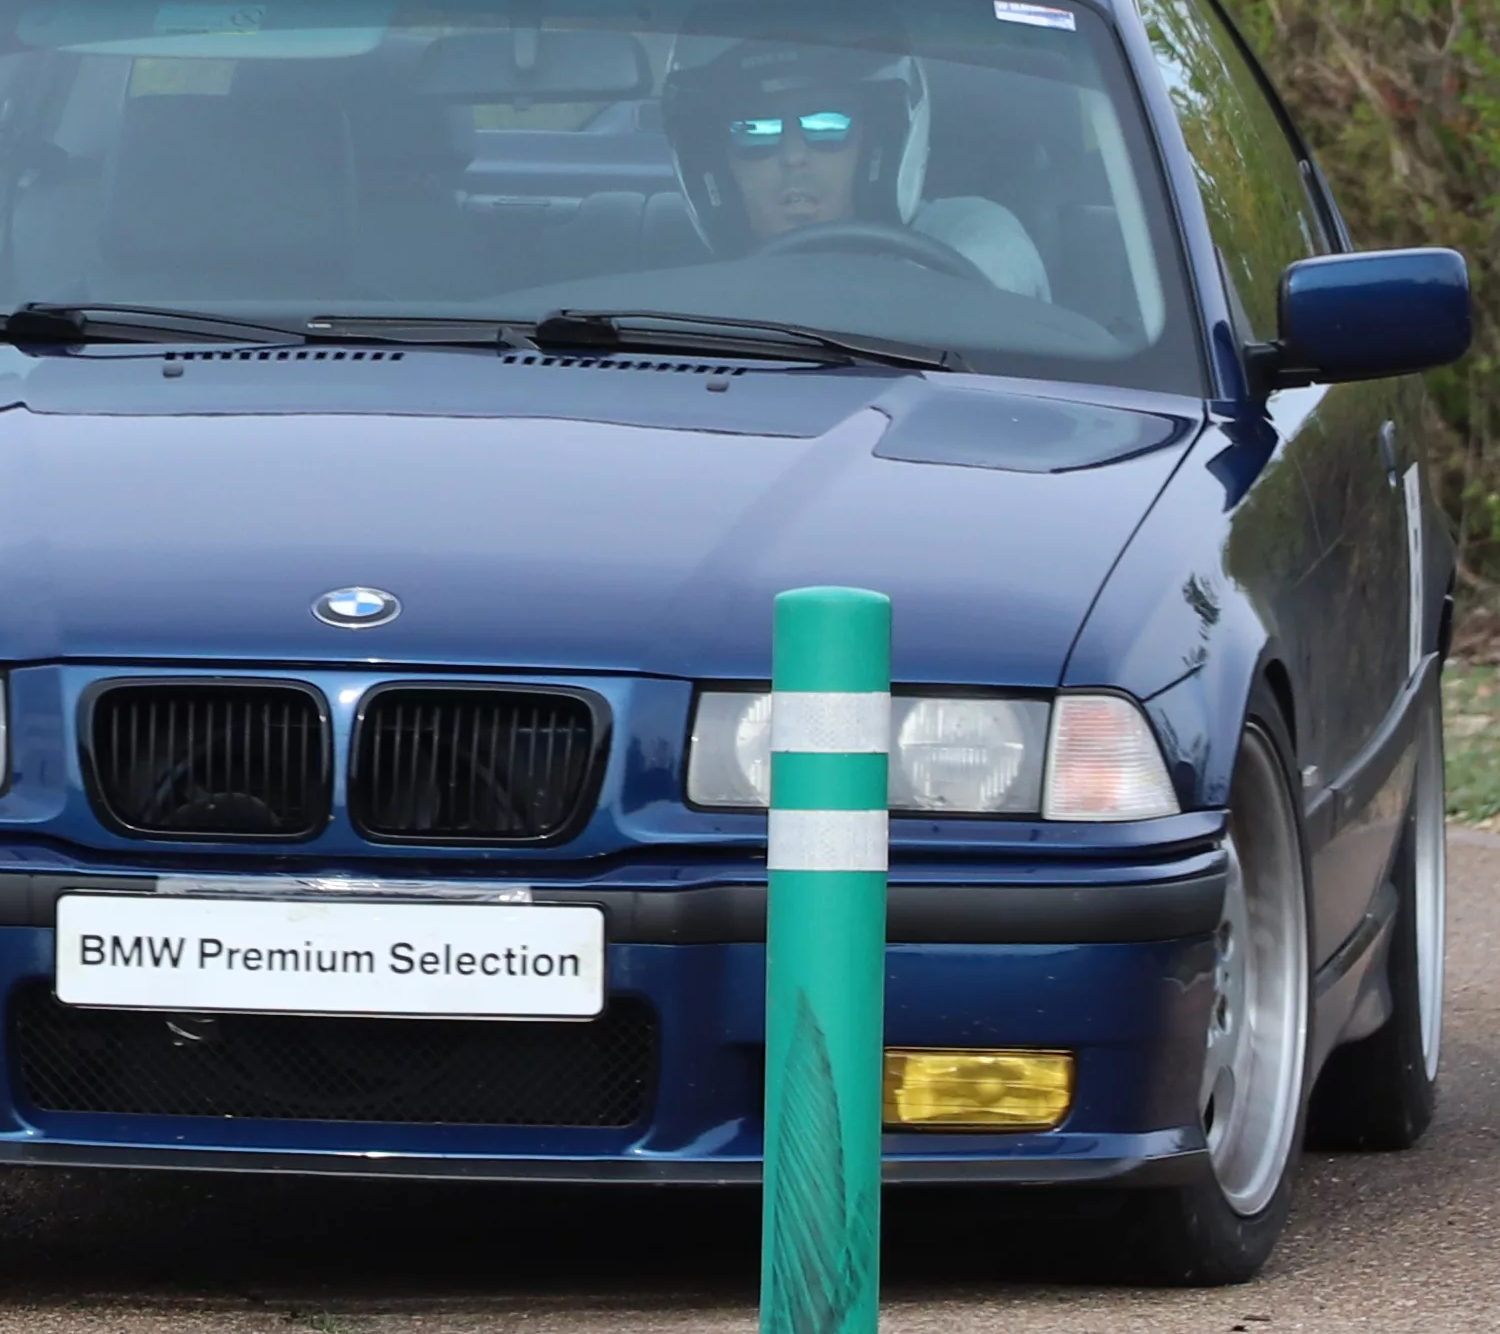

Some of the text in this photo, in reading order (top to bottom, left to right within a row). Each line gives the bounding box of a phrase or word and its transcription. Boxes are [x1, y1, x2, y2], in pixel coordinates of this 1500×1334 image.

[81, 933, 580, 977] BMW Premium Selection
